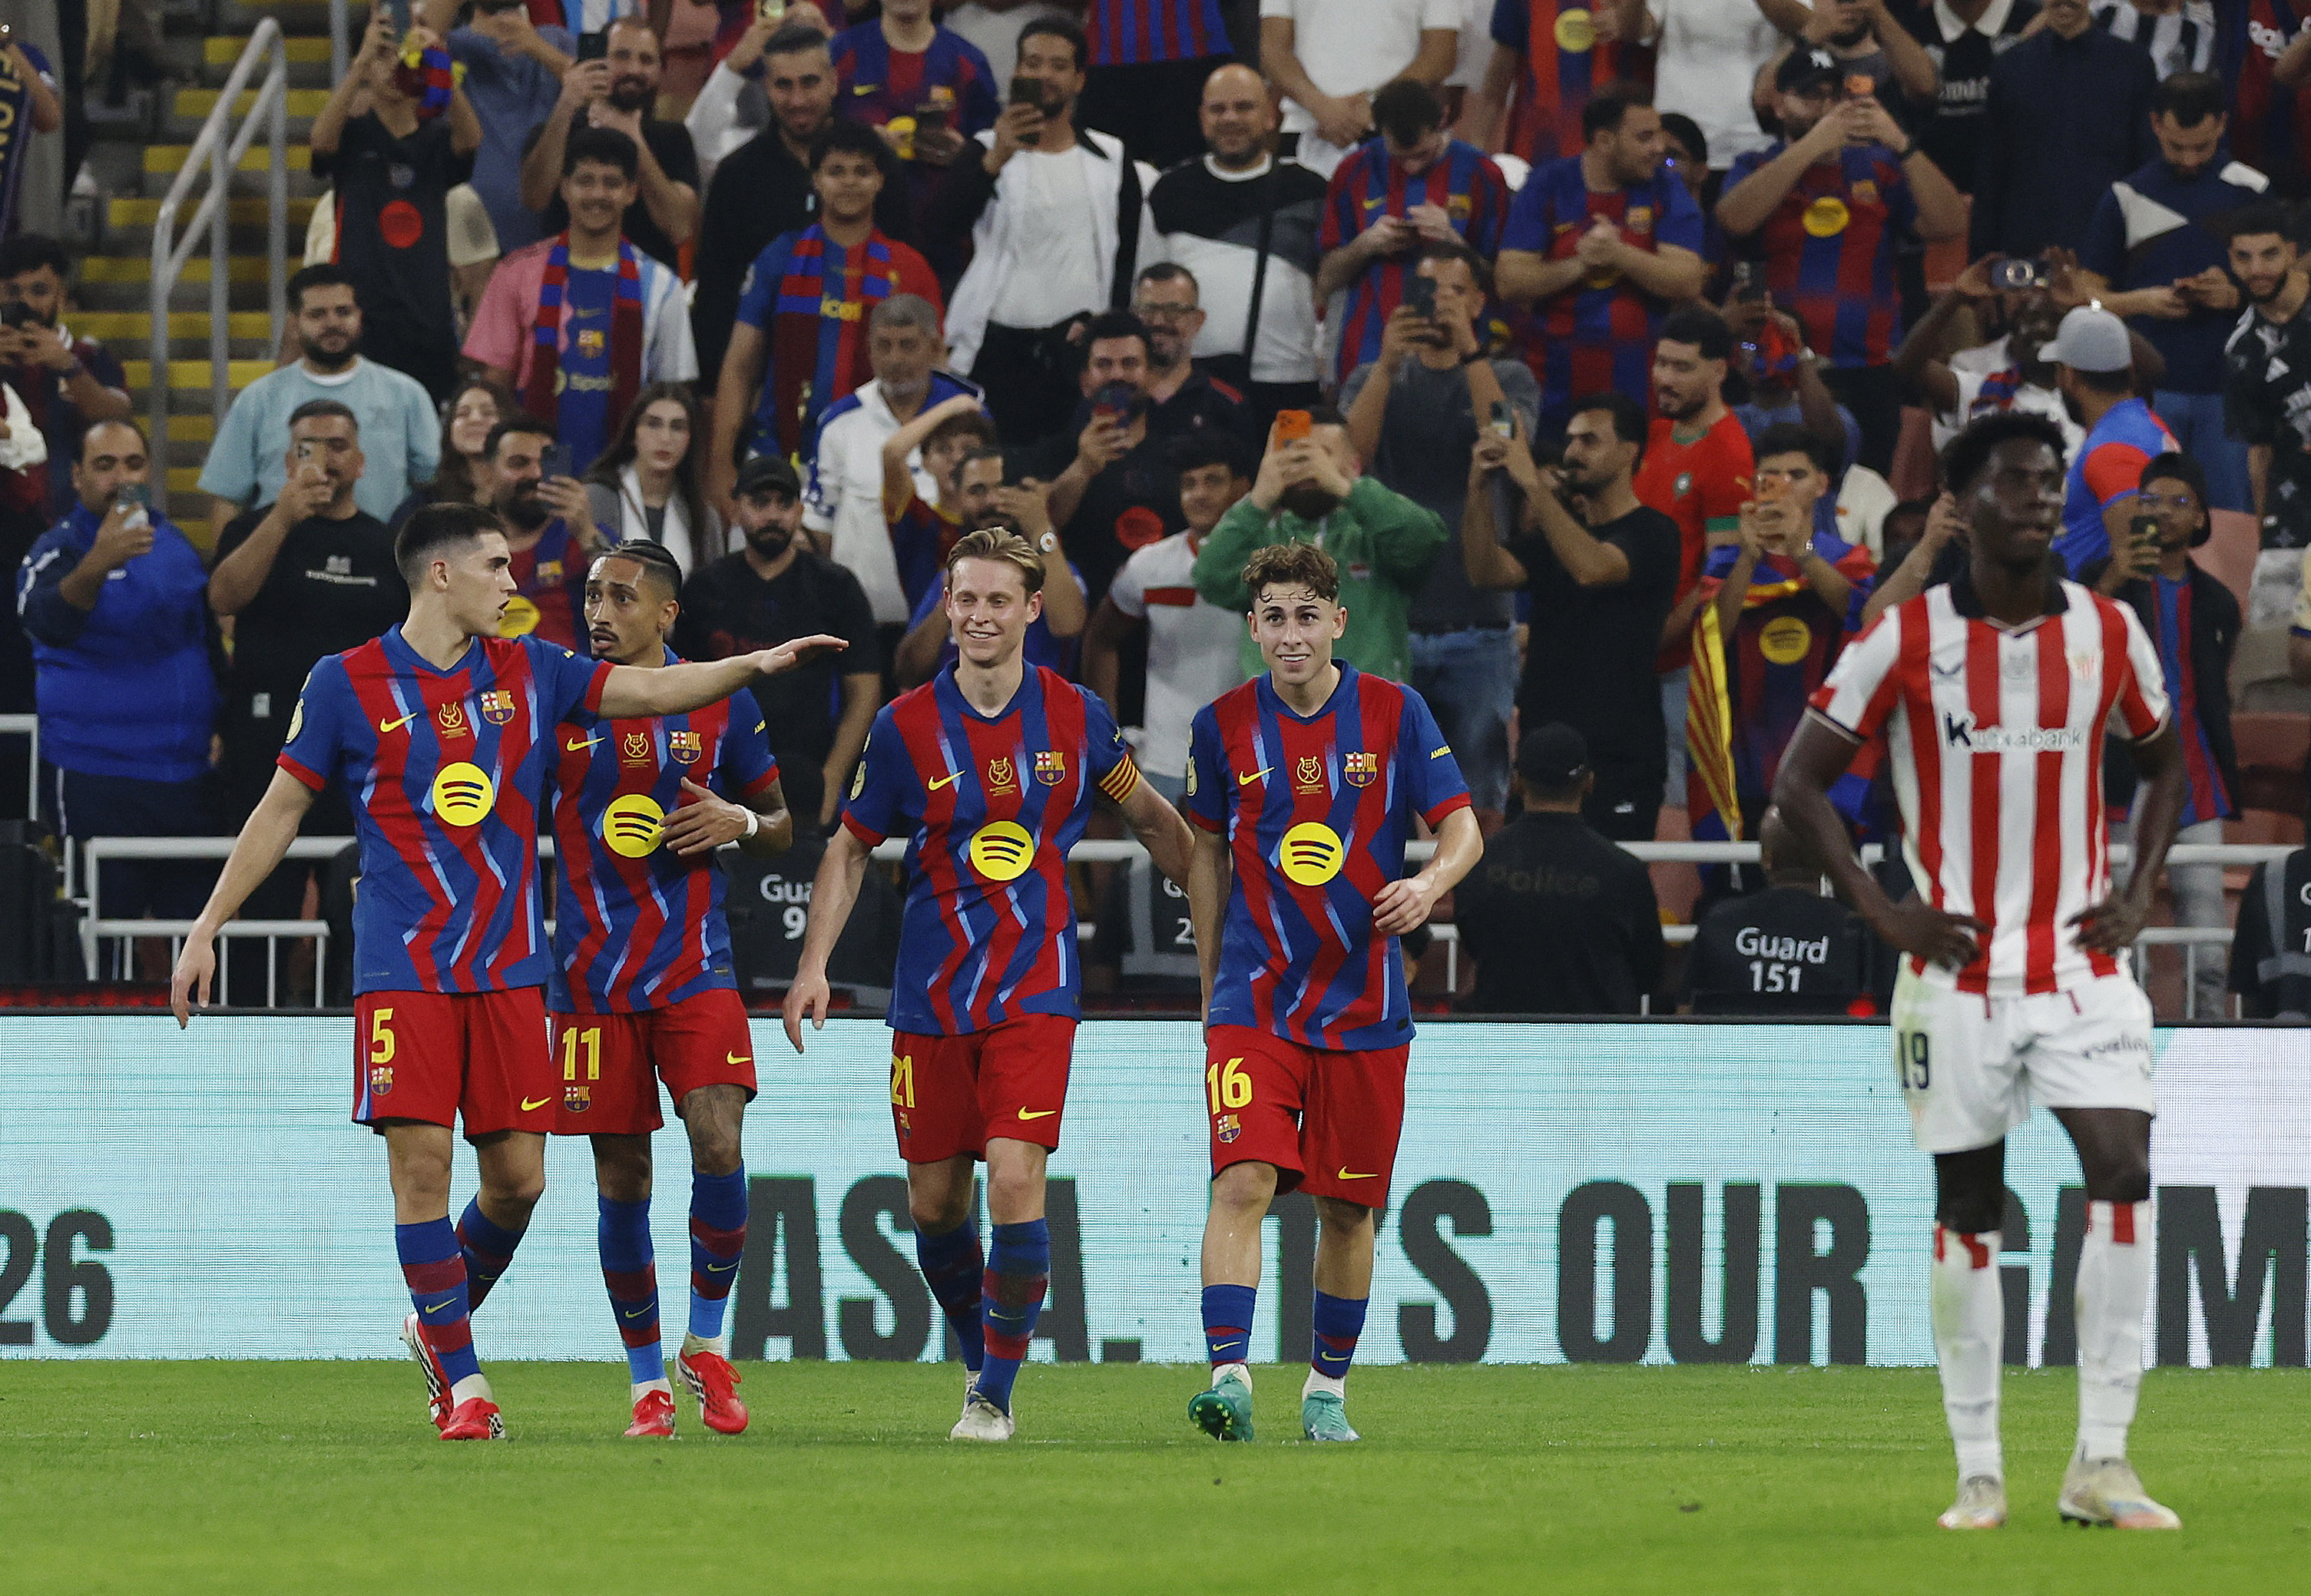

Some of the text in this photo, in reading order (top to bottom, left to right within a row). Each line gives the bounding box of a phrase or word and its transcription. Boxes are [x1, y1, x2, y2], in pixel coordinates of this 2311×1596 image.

[1174, 917, 1197, 945] 2
[1736, 926, 1829, 964] Guard
[1750, 959, 1802, 993] 151
[372, 1007, 396, 1064] 5
[561, 1027, 601, 1081] 11
[1899, 1031, 1929, 1089] 19
[891, 1053, 915, 1108] 21
[1207, 1057, 1253, 1115] 16
[0, 1210, 114, 1345] 26
[731, 1174, 1141, 1363] ASA.
[1558, 1181, 1869, 1364] OUR
